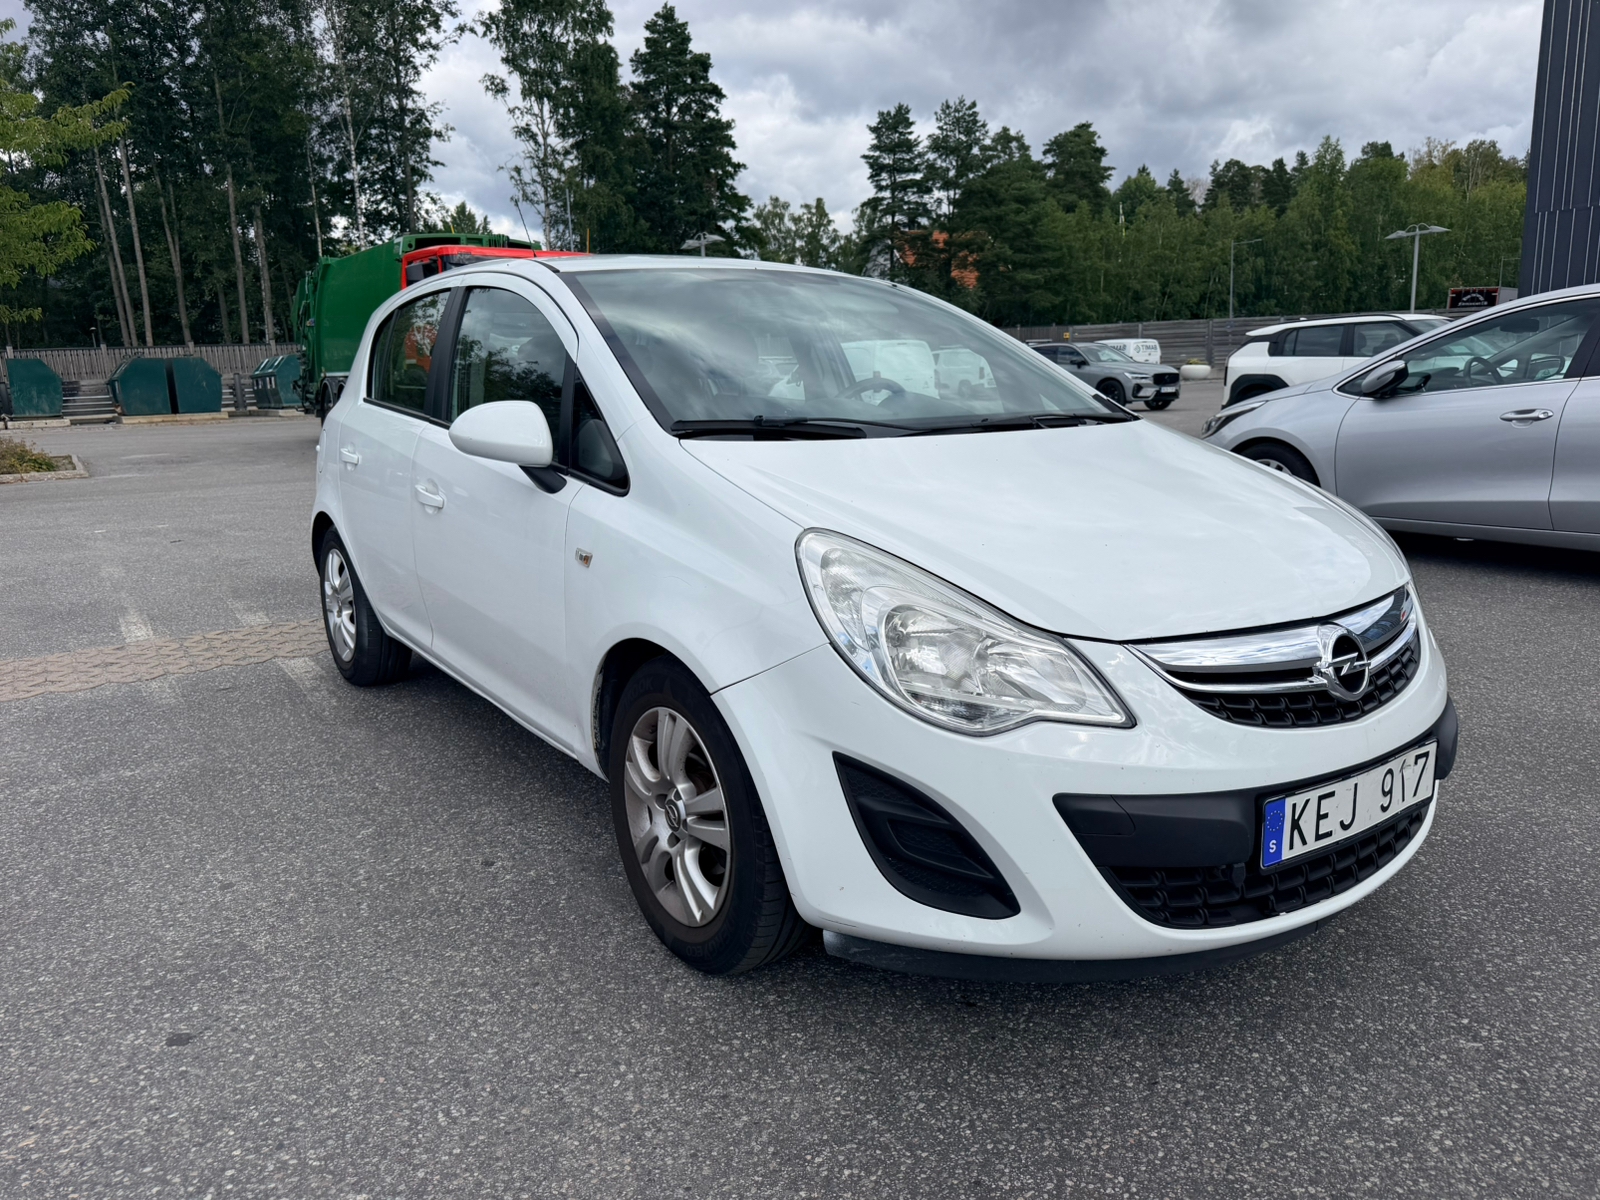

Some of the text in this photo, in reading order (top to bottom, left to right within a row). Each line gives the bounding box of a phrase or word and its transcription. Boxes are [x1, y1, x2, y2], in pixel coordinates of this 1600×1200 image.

[1289, 751, 1430, 850] KEJ 917
[1269, 839, 1277, 853] S
